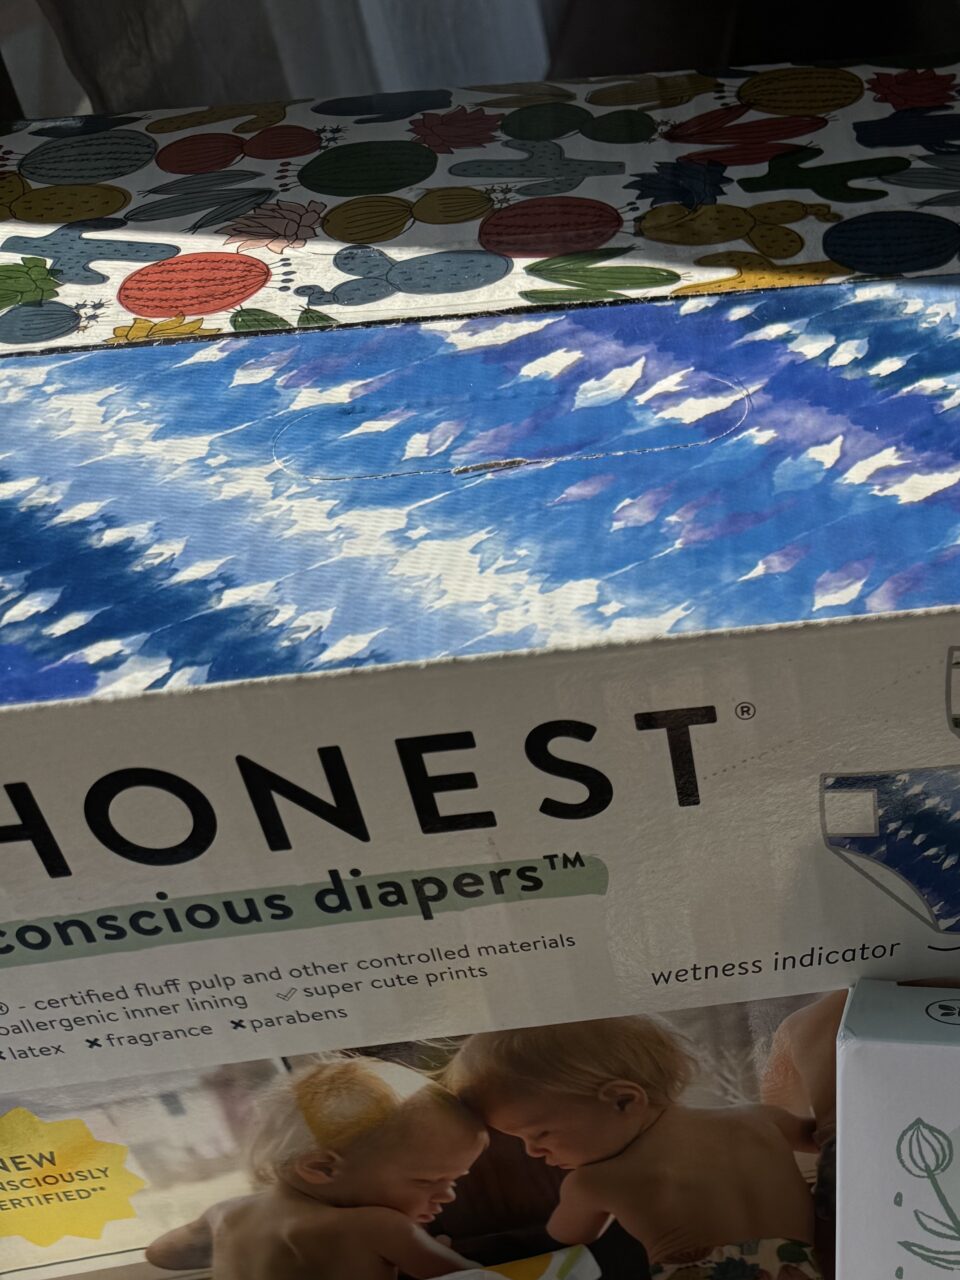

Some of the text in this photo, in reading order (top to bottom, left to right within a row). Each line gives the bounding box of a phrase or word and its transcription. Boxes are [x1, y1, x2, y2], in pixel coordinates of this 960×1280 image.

[34, 985, 129, 1010] certified
[134, 979, 181, 997] fluff
[188, 974, 236, 994] pulp
[243, 966, 282, 984] and
[289, 961, 348, 979] other
[357, 944, 470, 971] controlled
[477, 934, 576, 957] materials
[651, 941, 902, 986] wetness indicator
[303, 964, 488, 999] super cute prints
[0, 993, 248, 1036] oallergenic inner lining
[250, 1006, 348, 1031] parabens
[8, 1044, 65, 1060] latex
[106, 1023, 213, 1047] fragrance
